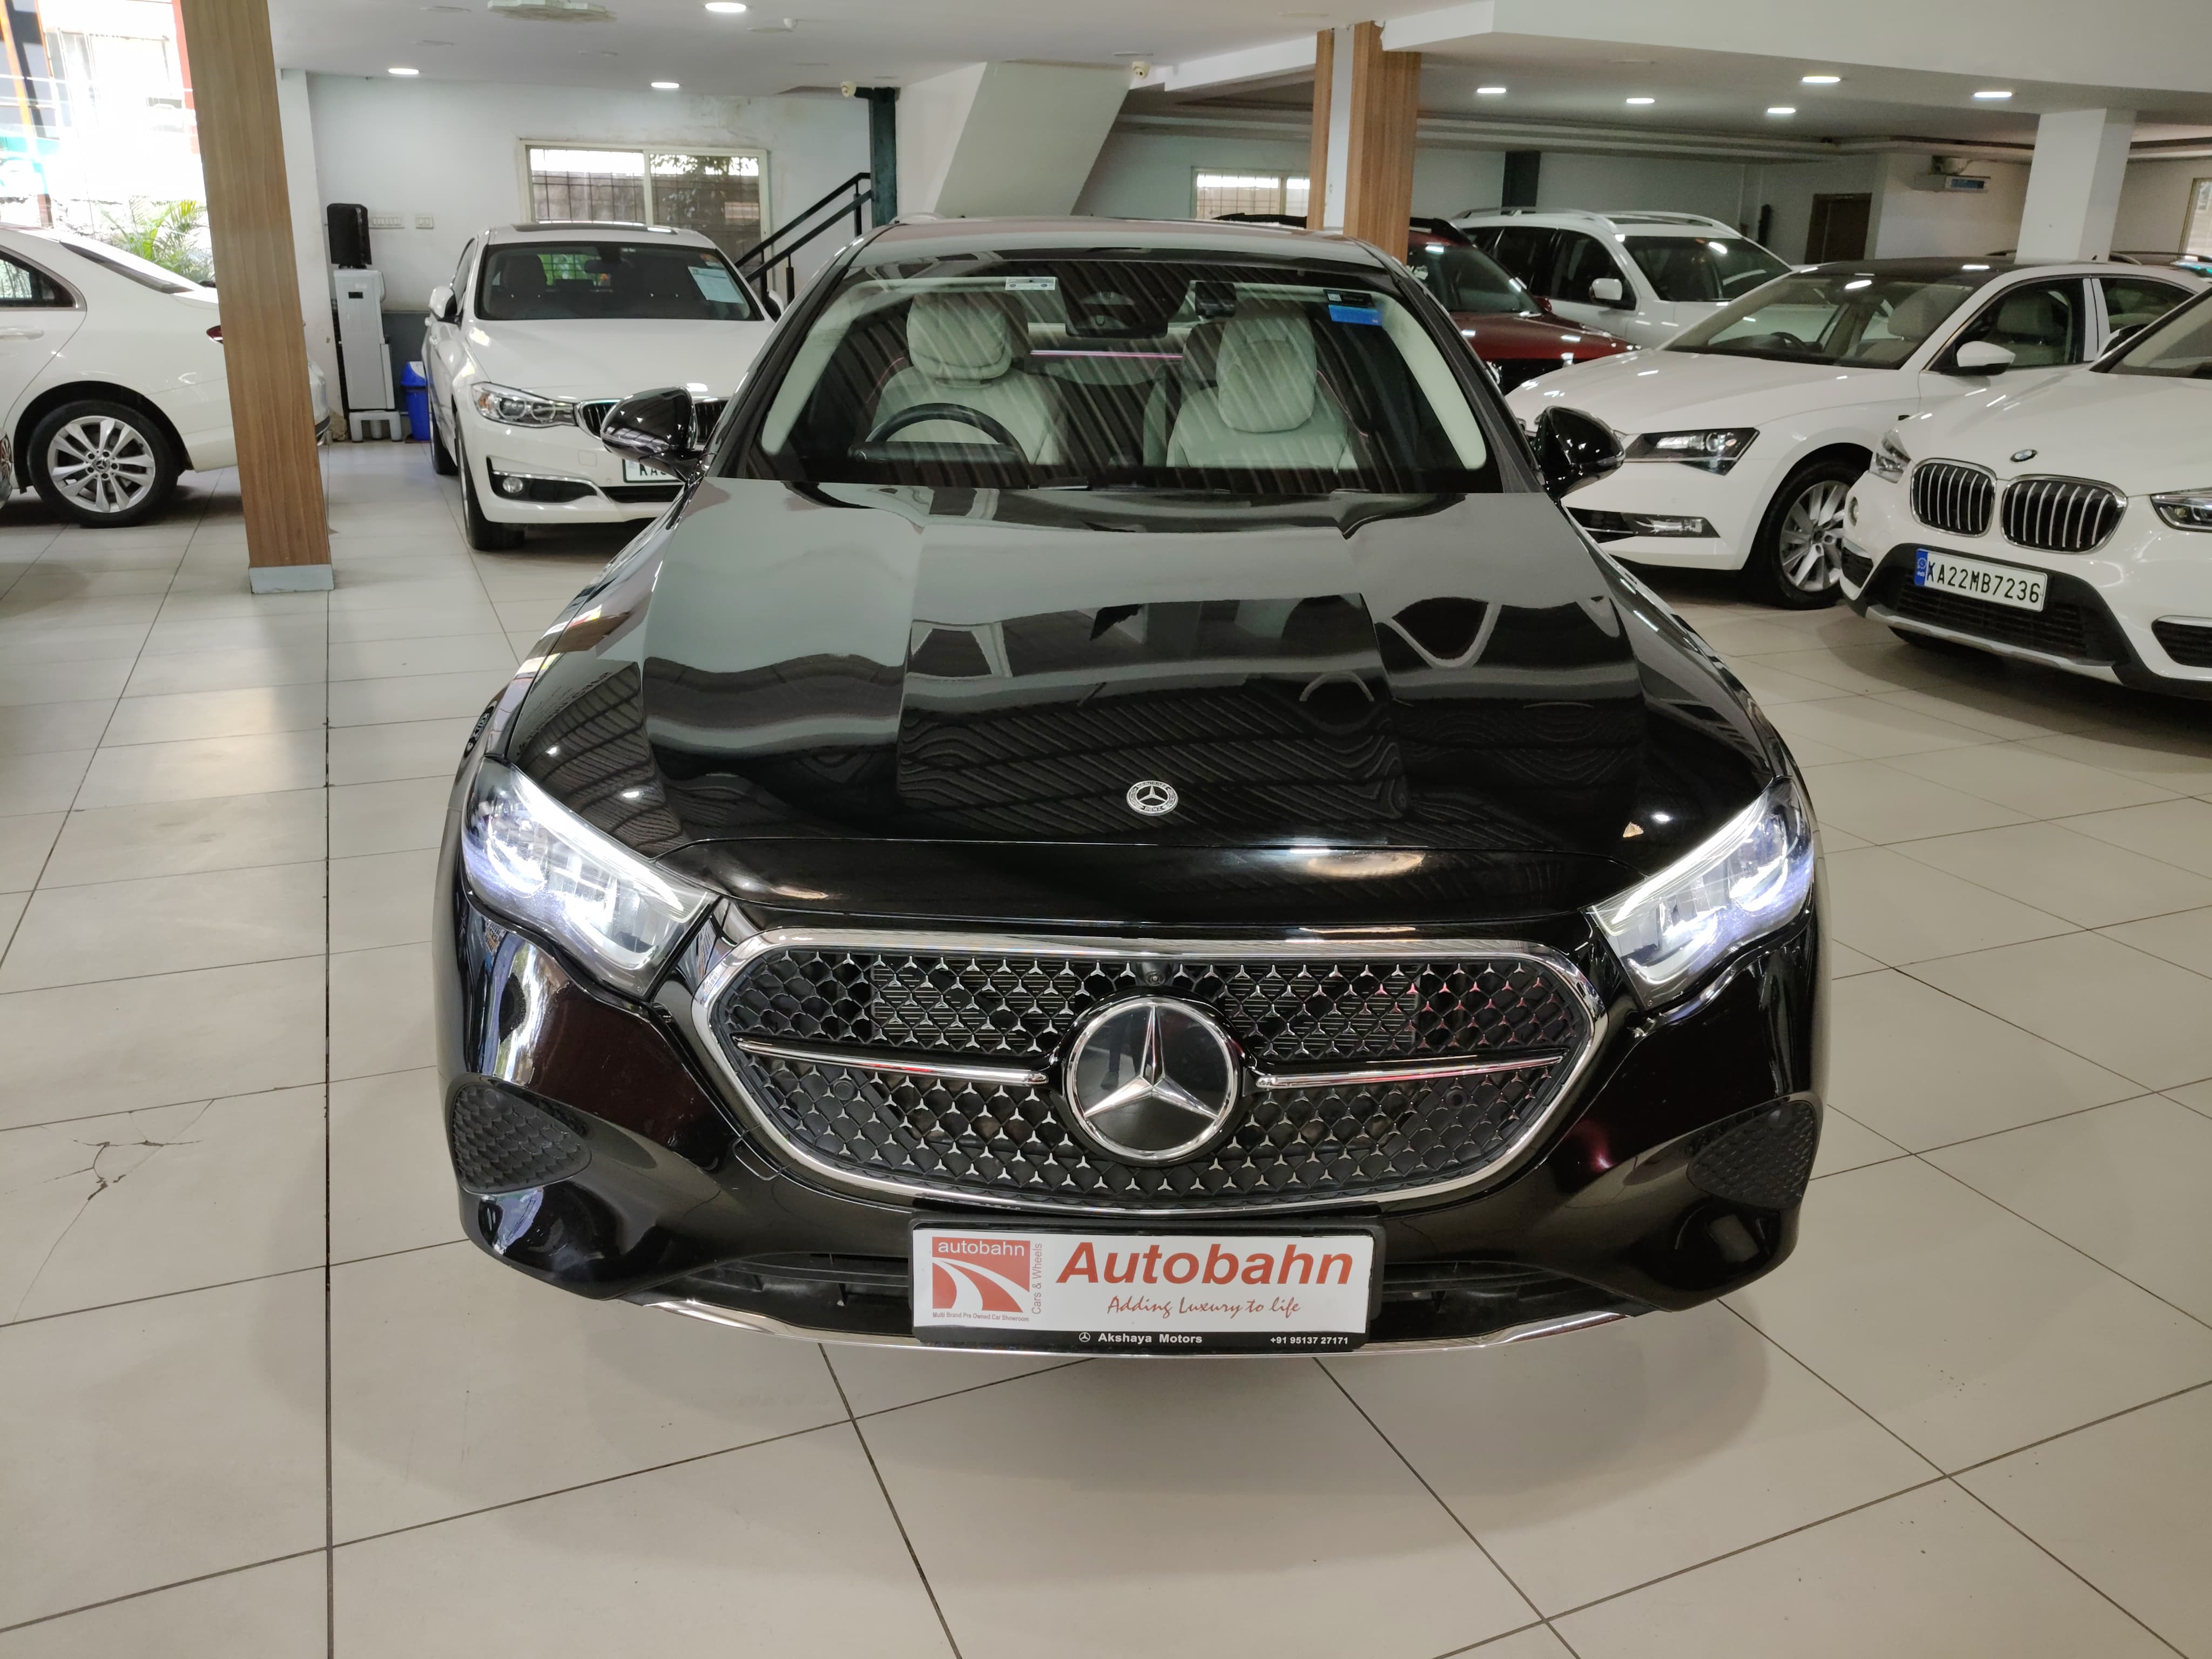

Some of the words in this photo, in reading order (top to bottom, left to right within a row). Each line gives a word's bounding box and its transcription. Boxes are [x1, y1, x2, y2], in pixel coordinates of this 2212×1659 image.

[1926, 561, 2041, 603] KA22MB7236
[938, 1240, 1025, 1257] autobahn
[1031, 1243, 1042, 1279] Wheels
[1056, 1242, 1353, 1284] Autobahn
[1031, 1282, 1042, 1290] &
[1031, 1292, 1042, 1314] Cars
[1107, 1295, 1173, 1319] Adding
[1178, 1296, 1243, 1319] Luxury
[1246, 1299, 1264, 1313] to
[1269, 1296, 1301, 1319] life
[1098, 1333, 1152, 1344] Akshaya
[1158, 1333, 1203, 1344] Motors
[1320, 1337, 1349, 1345] 27171
